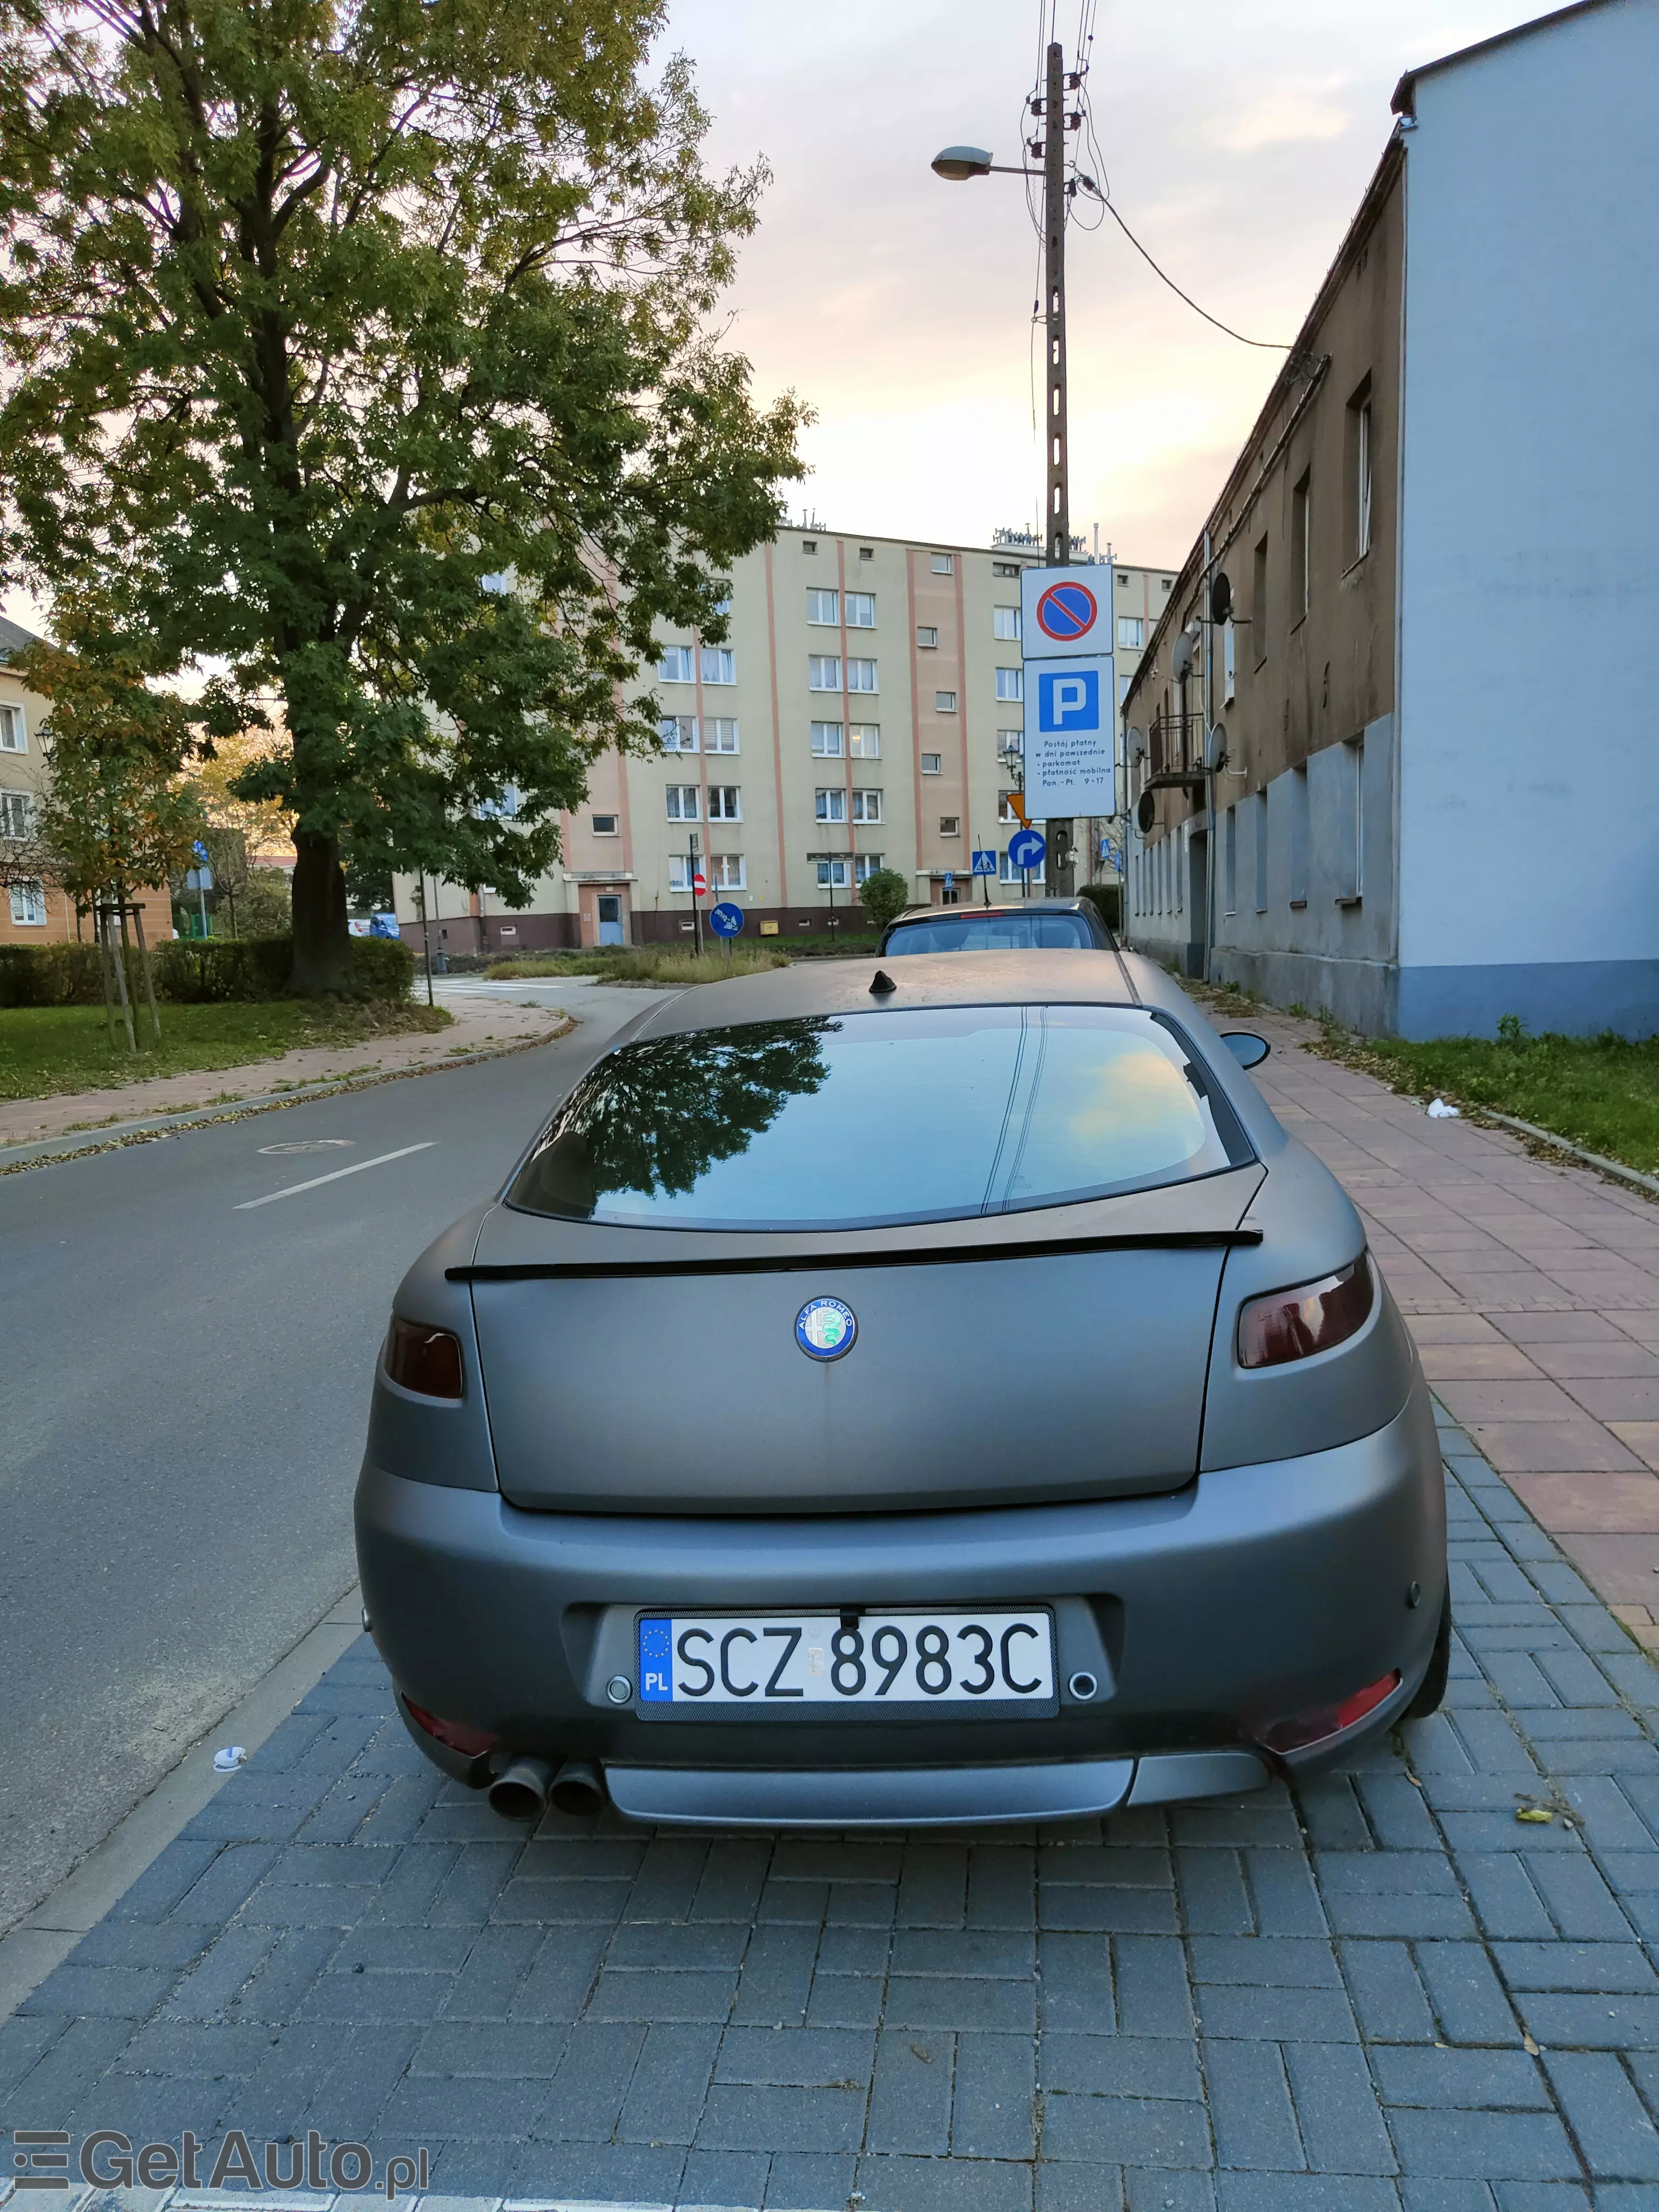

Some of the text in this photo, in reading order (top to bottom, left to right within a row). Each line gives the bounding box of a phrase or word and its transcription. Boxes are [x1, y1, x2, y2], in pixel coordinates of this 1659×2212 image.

[1053, 678, 1087, 725] P
[1044, 739, 1096, 748] Postój płatny
[1060, 748, 1105, 758] powszednie
[1042, 759, 1080, 768] parkomat
[1042, 768, 1077, 777] płatność
[799, 1300, 852, 1330] ALFA ROMEO
[677, 1623, 1042, 1697] SCZ 8983C
[645, 1673, 669, 1691] PL
